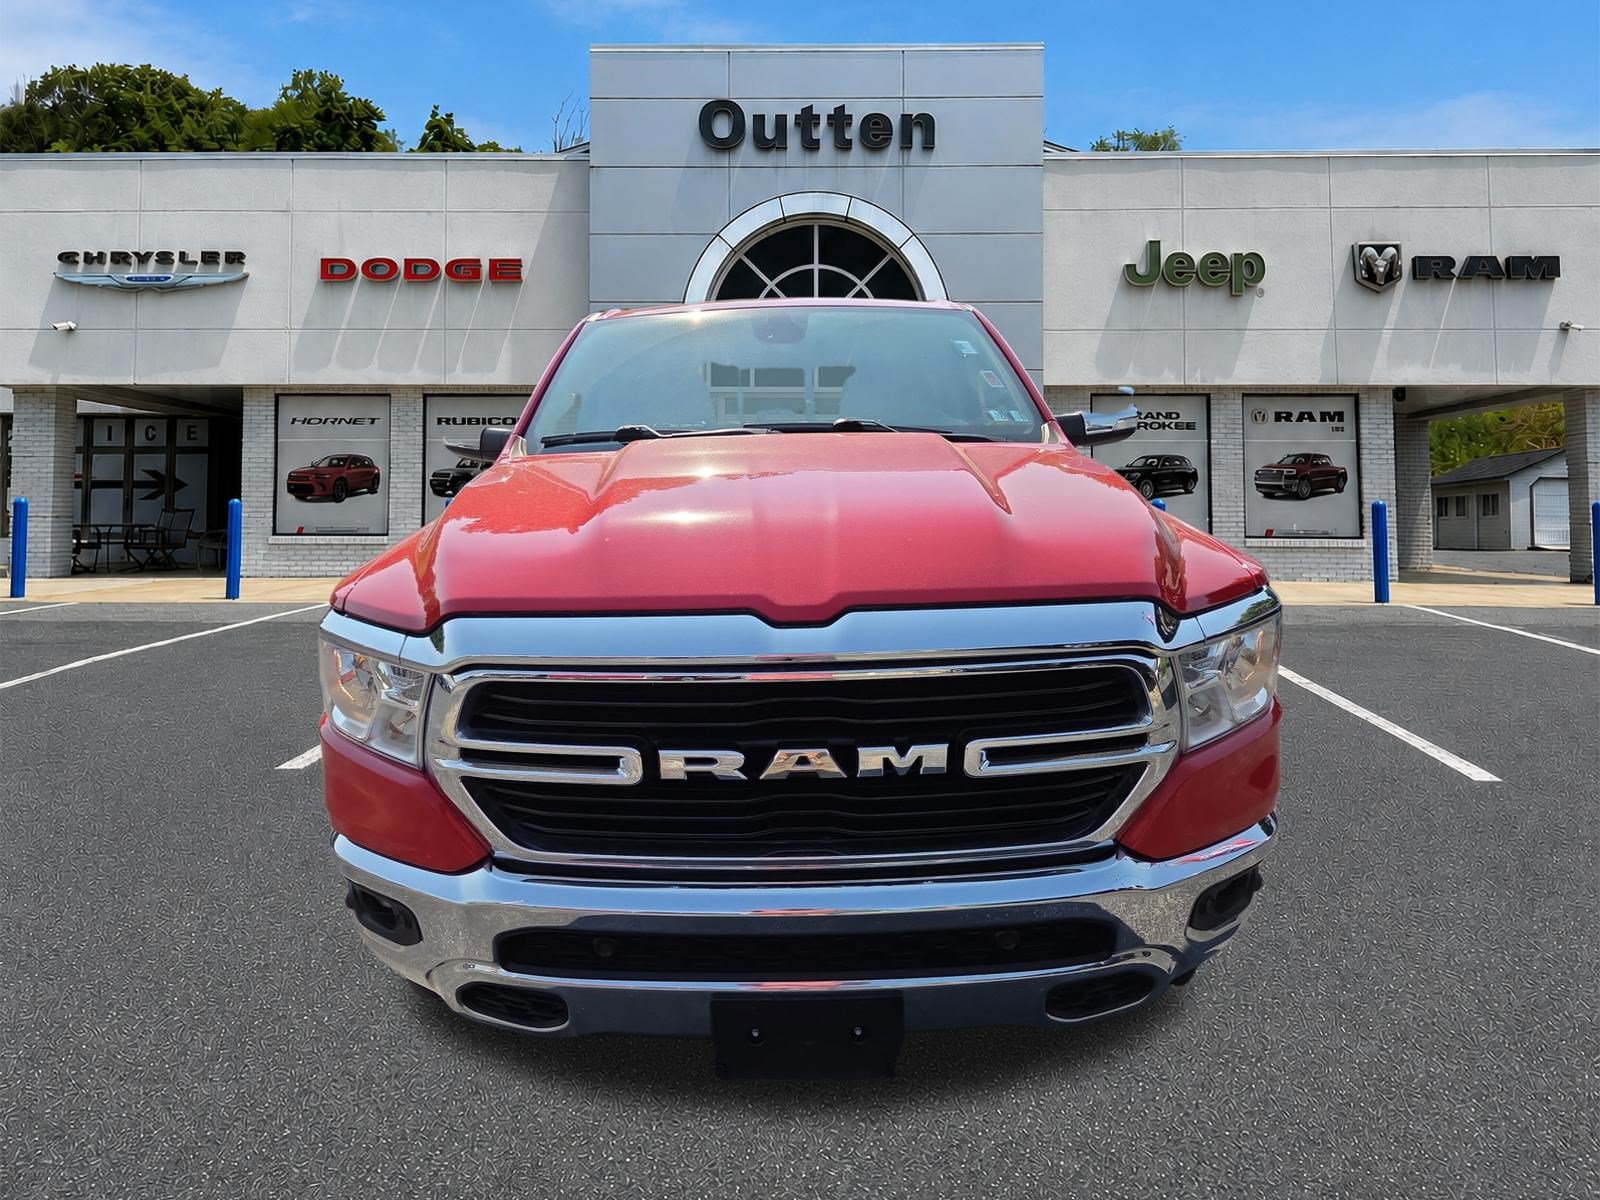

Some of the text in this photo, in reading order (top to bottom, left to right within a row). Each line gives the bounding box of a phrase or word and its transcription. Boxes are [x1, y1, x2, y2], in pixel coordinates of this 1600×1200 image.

[699, 99, 936, 150] Outten
[57, 250, 246, 265] CHRYSLER
[320, 257, 523, 282] DODGE
[1123, 240, 1266, 296] Jeep
[1411, 255, 1560, 280] RAM
[290, 417, 381, 425] HORNET
[436, 417, 520, 425] RUBICO
[1136, 411, 1180, 420] RAND
[1274, 411, 1345, 422] RAM
[1137, 421, 1196, 430] ROKEE
[658, 743, 949, 780] RAM
